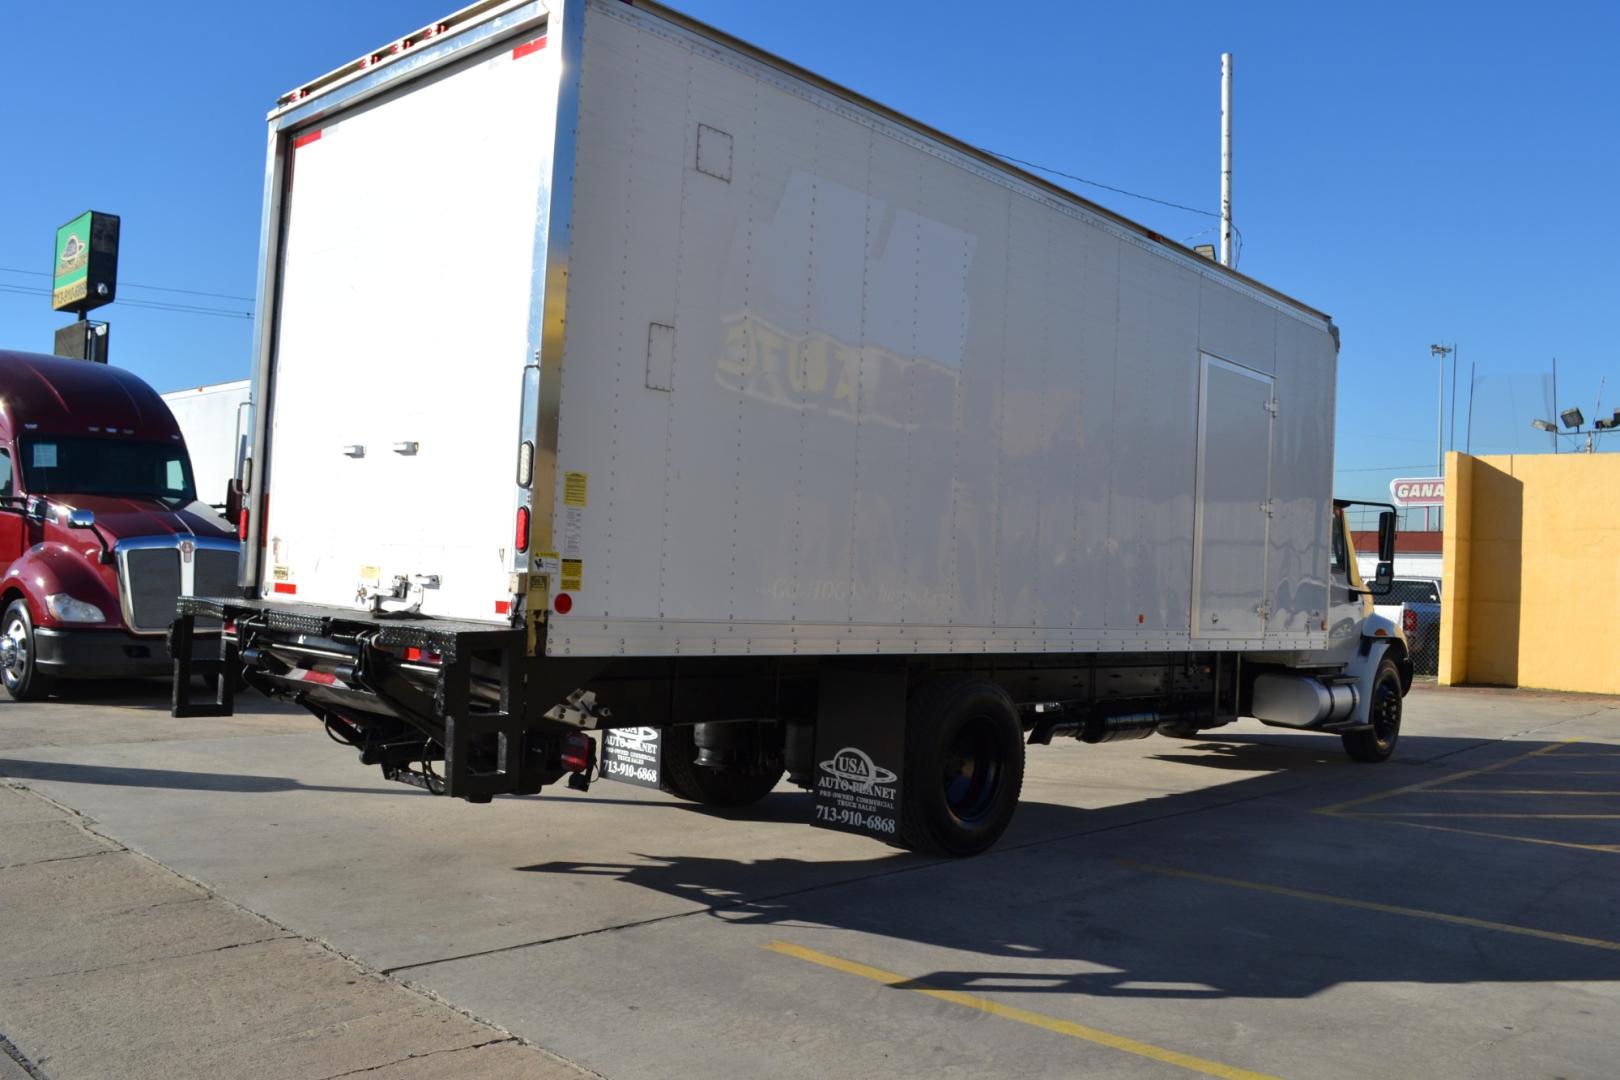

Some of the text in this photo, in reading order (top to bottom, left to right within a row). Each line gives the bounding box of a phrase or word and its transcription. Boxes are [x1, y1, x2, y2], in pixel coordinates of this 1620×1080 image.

[1398, 484, 1444, 498] GANA
[604, 760, 657, 782] 713-910-6868
[838, 757, 868, 775] USA
[837, 800, 877, 812] TRUCK SALES
[856, 796, 895, 809] COMMERCIAL
[816, 805, 896, 833] 713-910-6868
